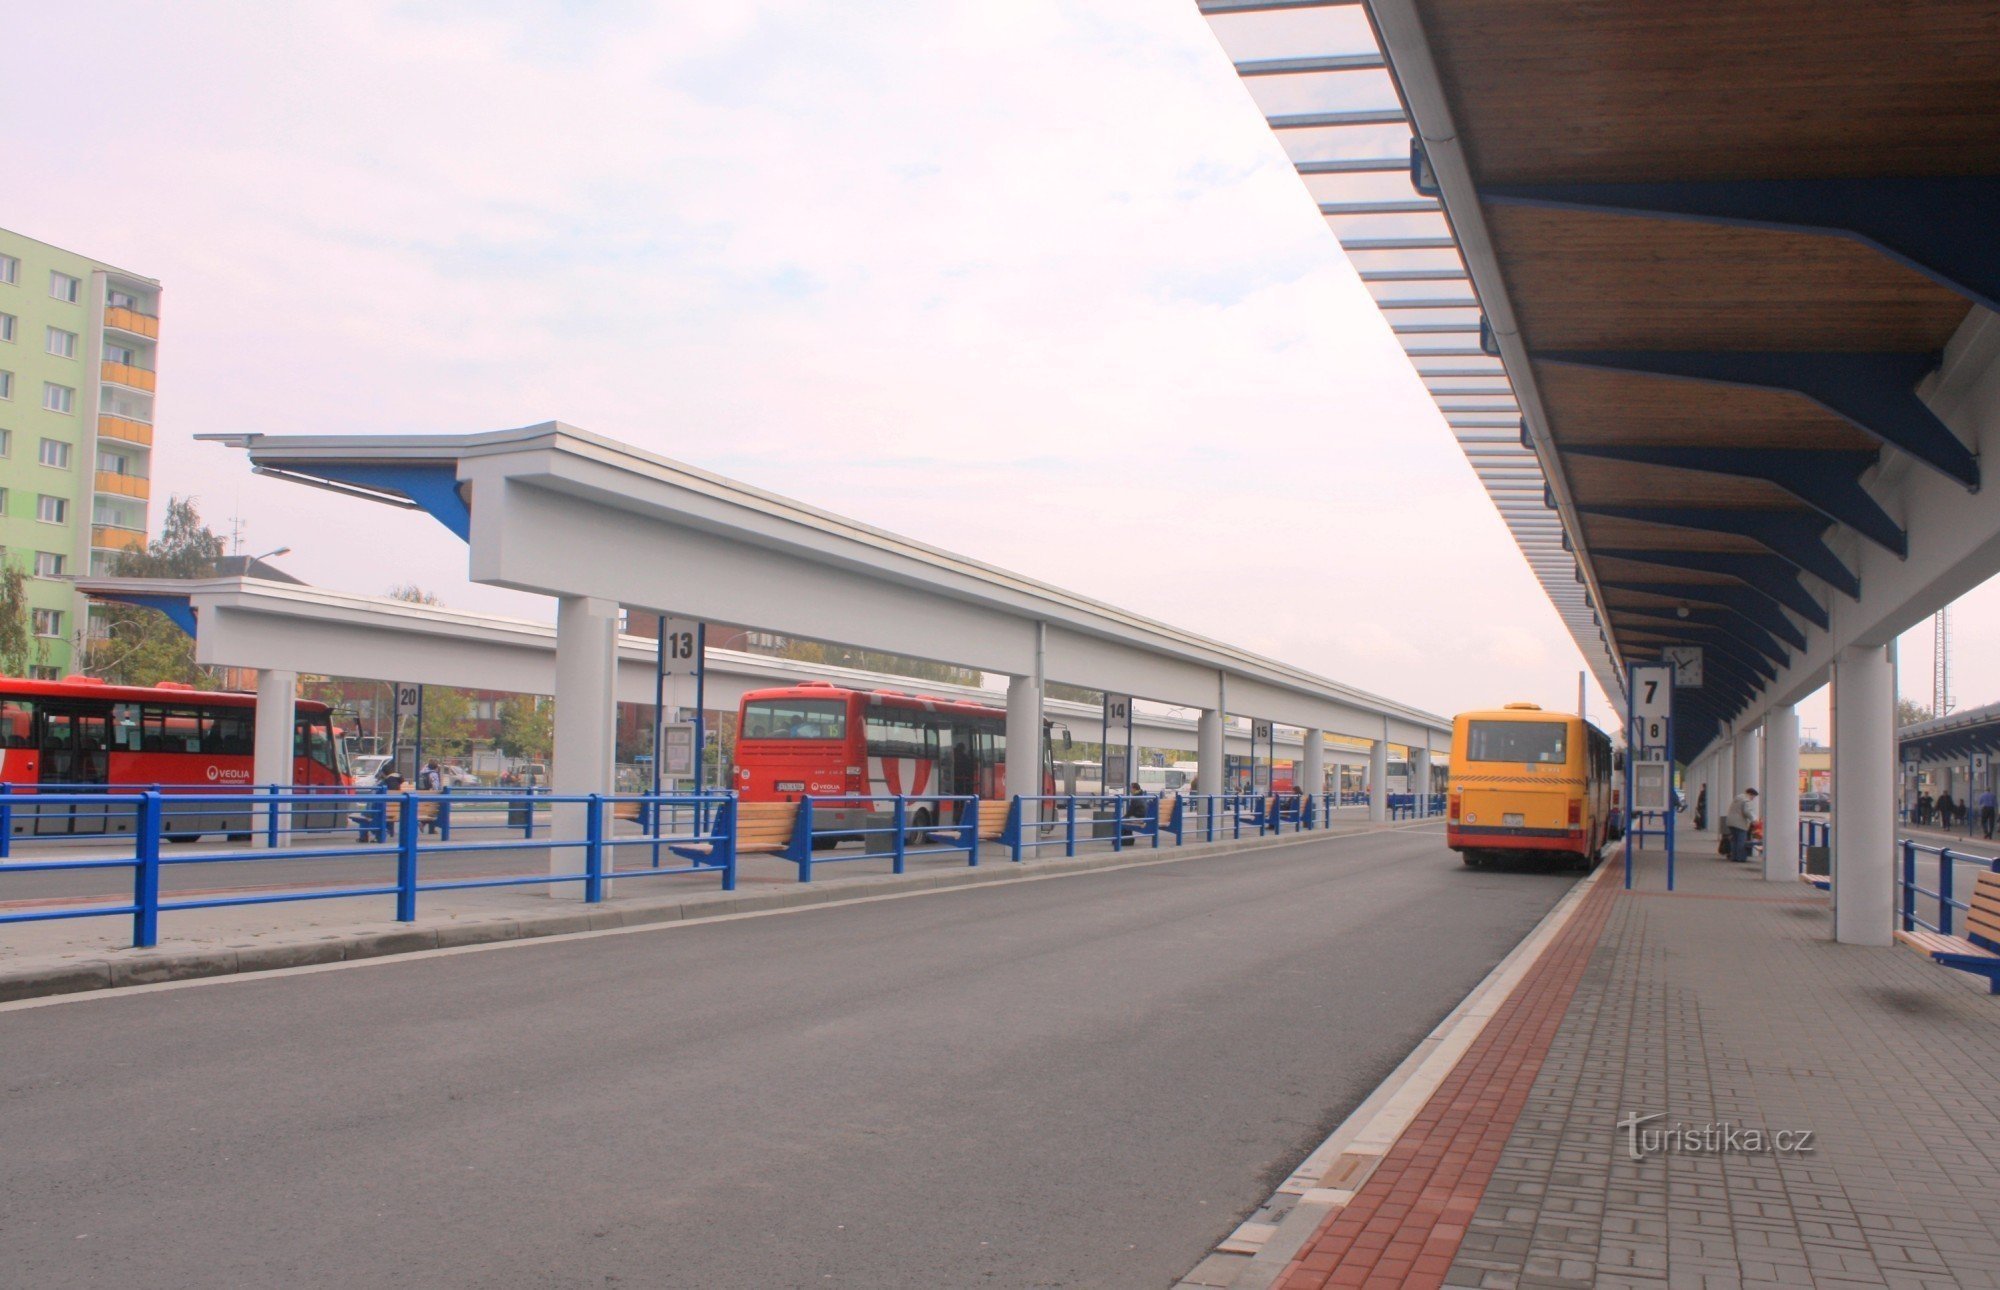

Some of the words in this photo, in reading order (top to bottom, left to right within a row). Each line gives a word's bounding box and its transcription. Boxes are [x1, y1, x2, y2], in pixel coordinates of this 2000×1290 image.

[669, 632, 693, 659] 13
[400, 687, 417, 706] 20
[1644, 681, 1658, 704] 7
[1110, 703, 1125, 718] 14
[1256, 726, 1268, 738] 15
[1650, 723, 1659, 738] 8
[1975, 758, 1982, 768] 3
[219, 769, 250, 778] VEOLIA
